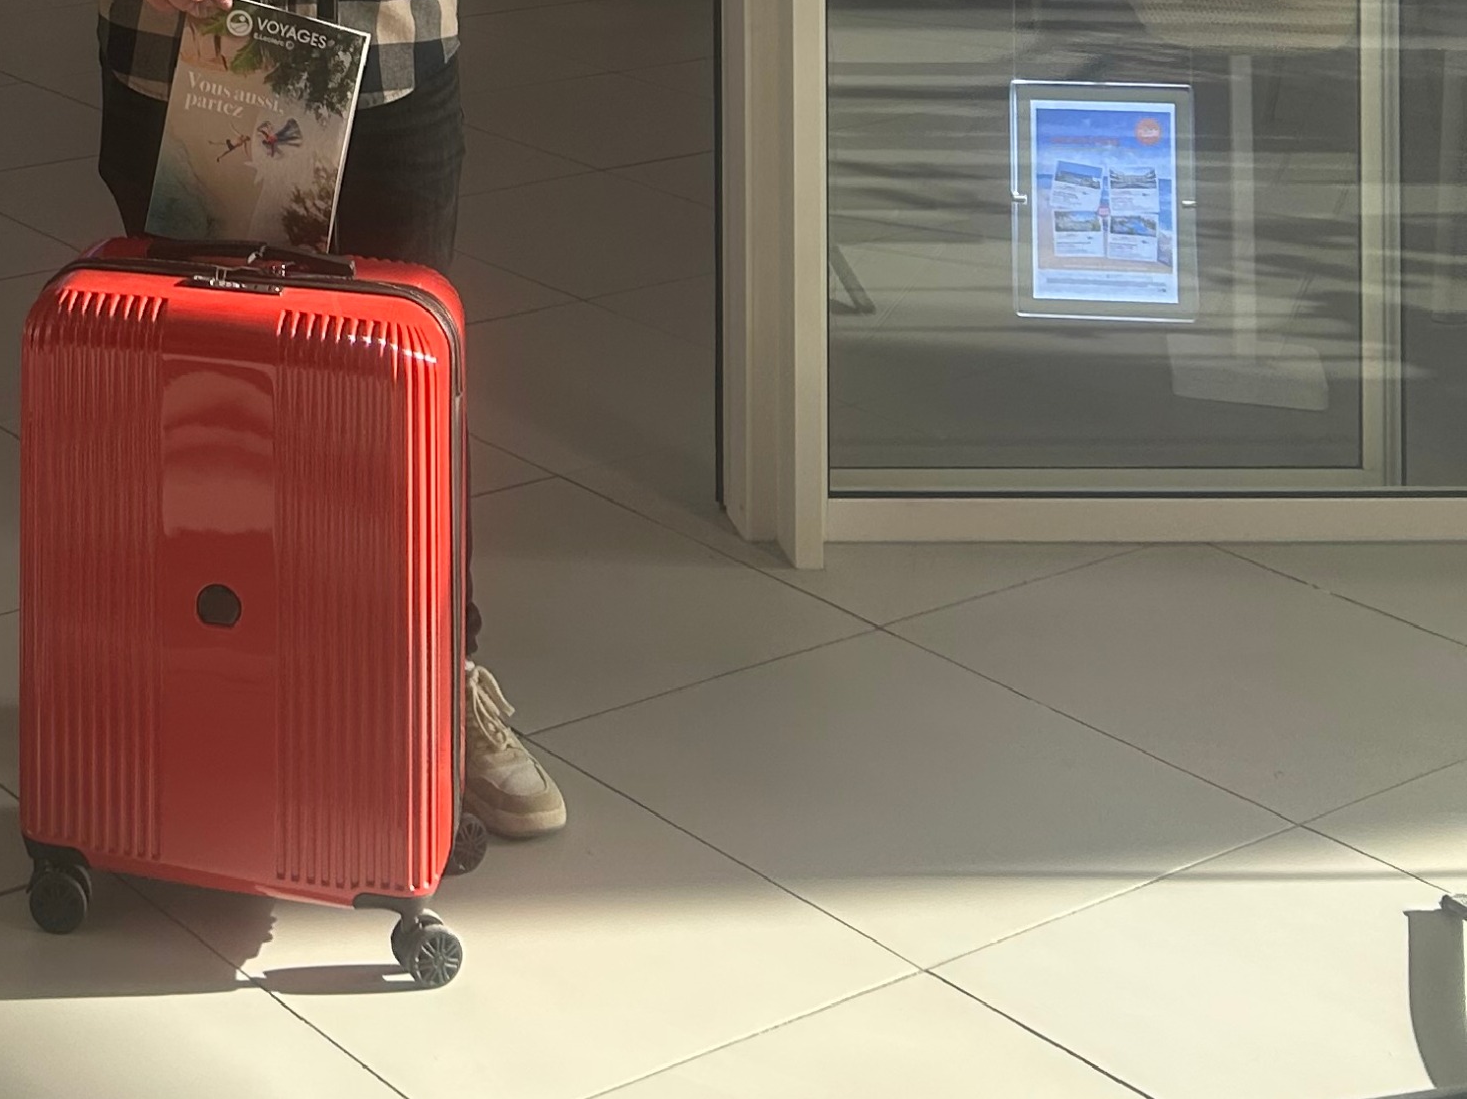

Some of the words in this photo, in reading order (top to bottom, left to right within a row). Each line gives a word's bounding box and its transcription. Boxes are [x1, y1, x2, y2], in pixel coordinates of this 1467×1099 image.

[257, 17, 327, 49] VOYAGES
[184, 93, 243, 118] partez
[189, 71, 231, 98] Vous
[234, 89, 284, 115] aussi,
